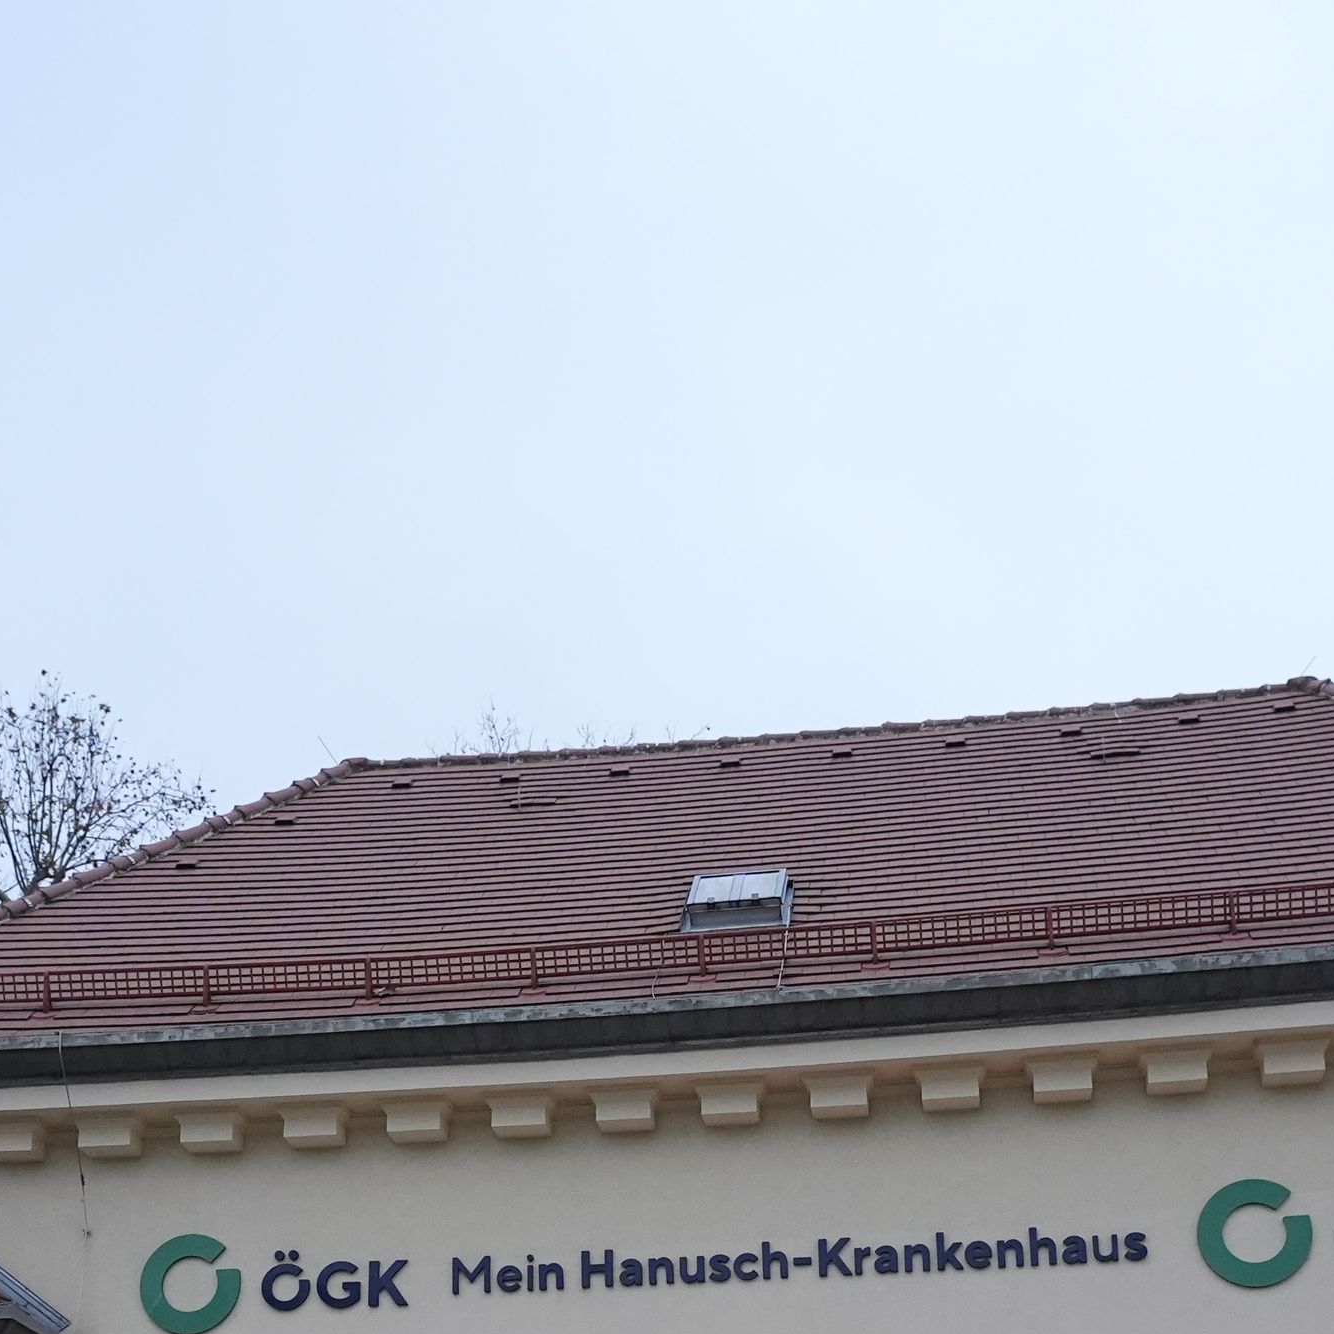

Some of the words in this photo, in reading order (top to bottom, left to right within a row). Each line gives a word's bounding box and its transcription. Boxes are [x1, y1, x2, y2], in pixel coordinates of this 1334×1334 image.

[261, 1249, 409, 1311] ÖGK
[452, 1254, 565, 1295] Mein
[581, 1227, 1148, 1289] Hanusch-Krankenhaus
